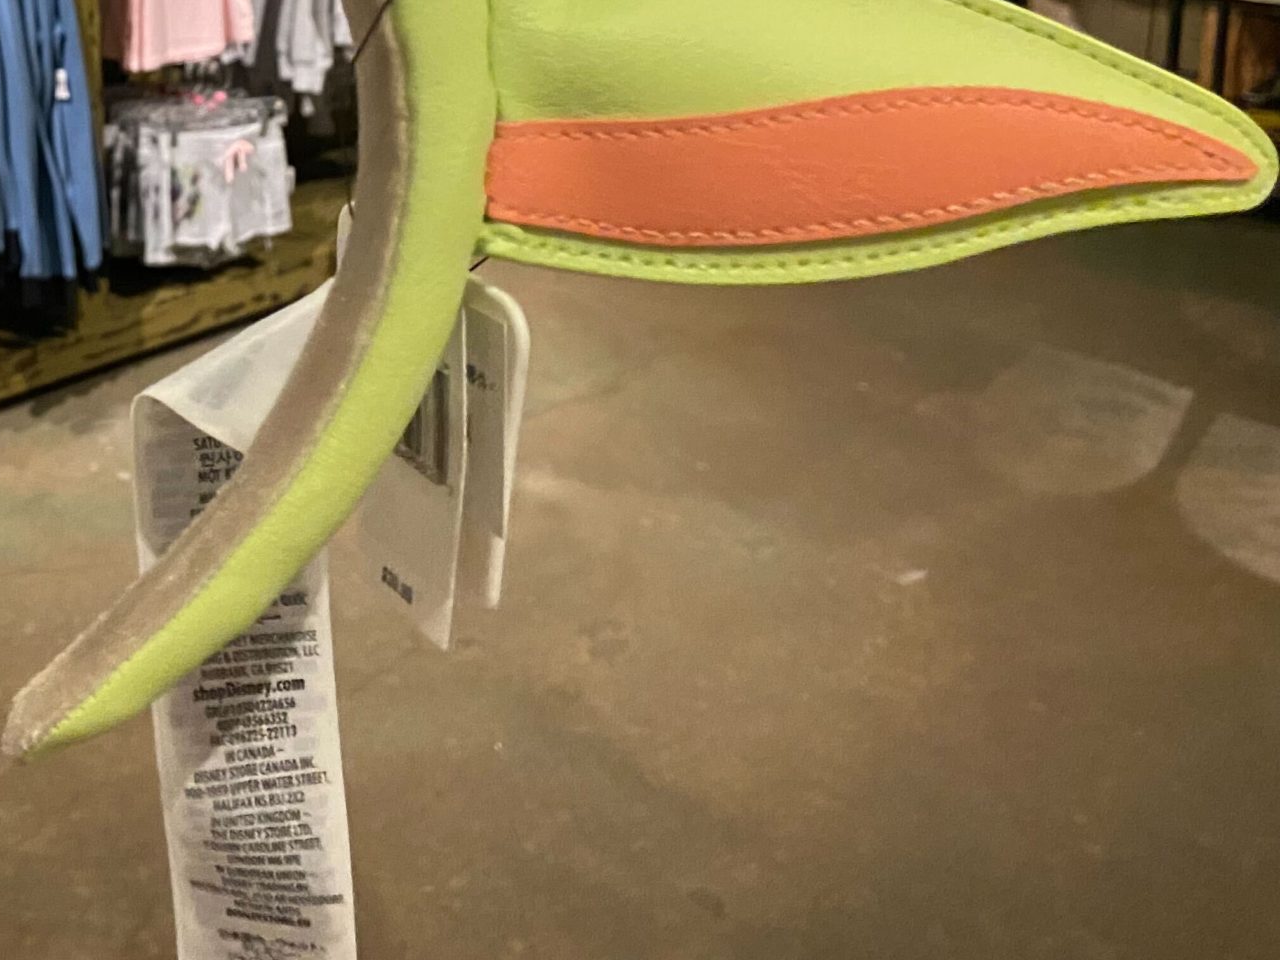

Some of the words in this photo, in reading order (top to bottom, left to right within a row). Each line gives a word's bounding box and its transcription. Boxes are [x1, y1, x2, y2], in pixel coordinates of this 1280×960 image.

[193, 677, 305, 703] shopDisney.com
[237, 746, 276, 763] CANADA
[259, 759, 299, 775] CANADA
[256, 809, 301, 826] KINGDOM
